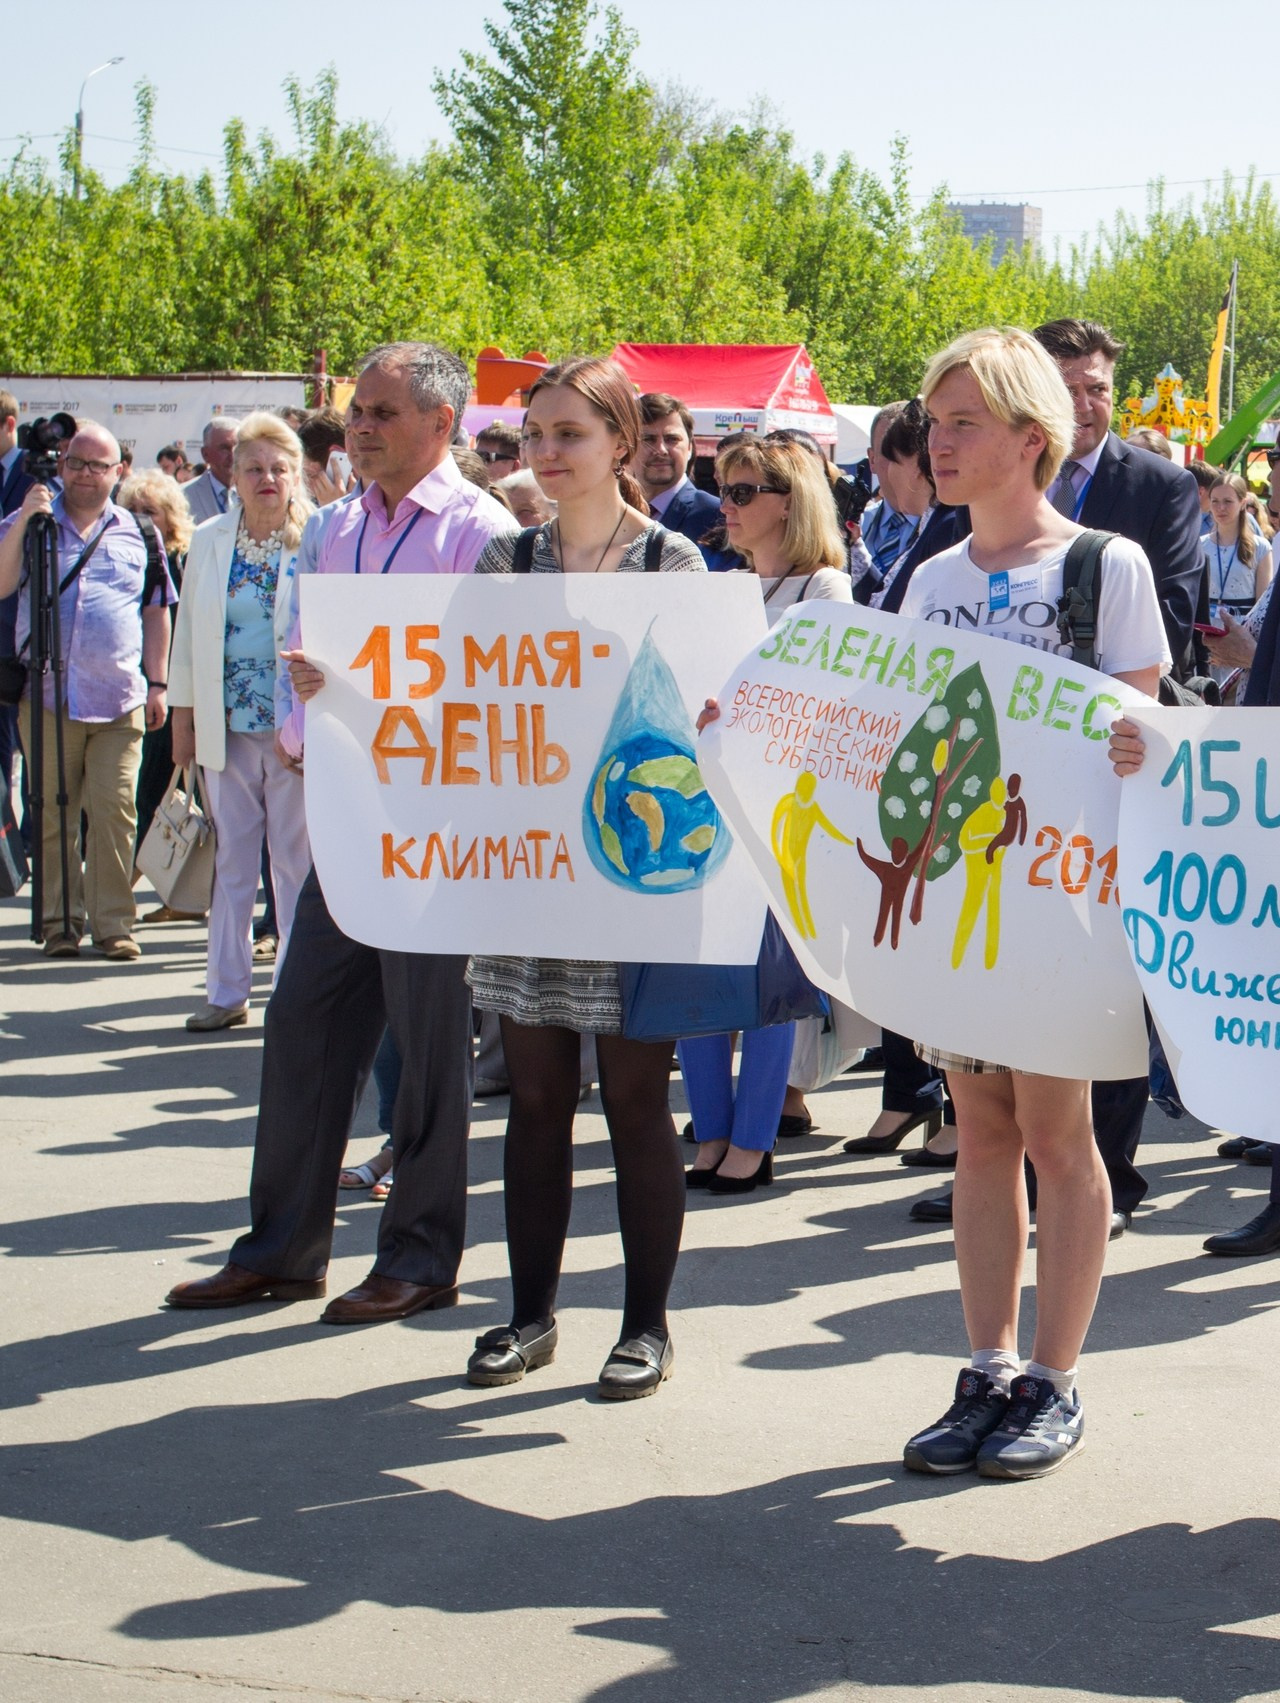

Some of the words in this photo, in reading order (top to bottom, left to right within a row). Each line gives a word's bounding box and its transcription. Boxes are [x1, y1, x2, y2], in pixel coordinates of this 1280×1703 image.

[349, 624, 446, 700] 15
[759, 618, 955, 700] ЗЕЛЕНАЯ
[1005, 664, 1123, 741] ВЕС
[371, 702, 571, 786] ДЕНЬ
[726, 707, 893, 766] ЭКОЛОГИЧЕСКИЙ
[734, 680, 901, 742] ВСЕРОССИЙСКИЙ
[765, 741, 885, 795] СУББОТНИК
[1161, 739, 1241, 828] 15
[381, 829, 575, 882] КЛИМАТА
[1028, 825, 1120, 907] 201
[1143, 851, 1247, 925] 100
